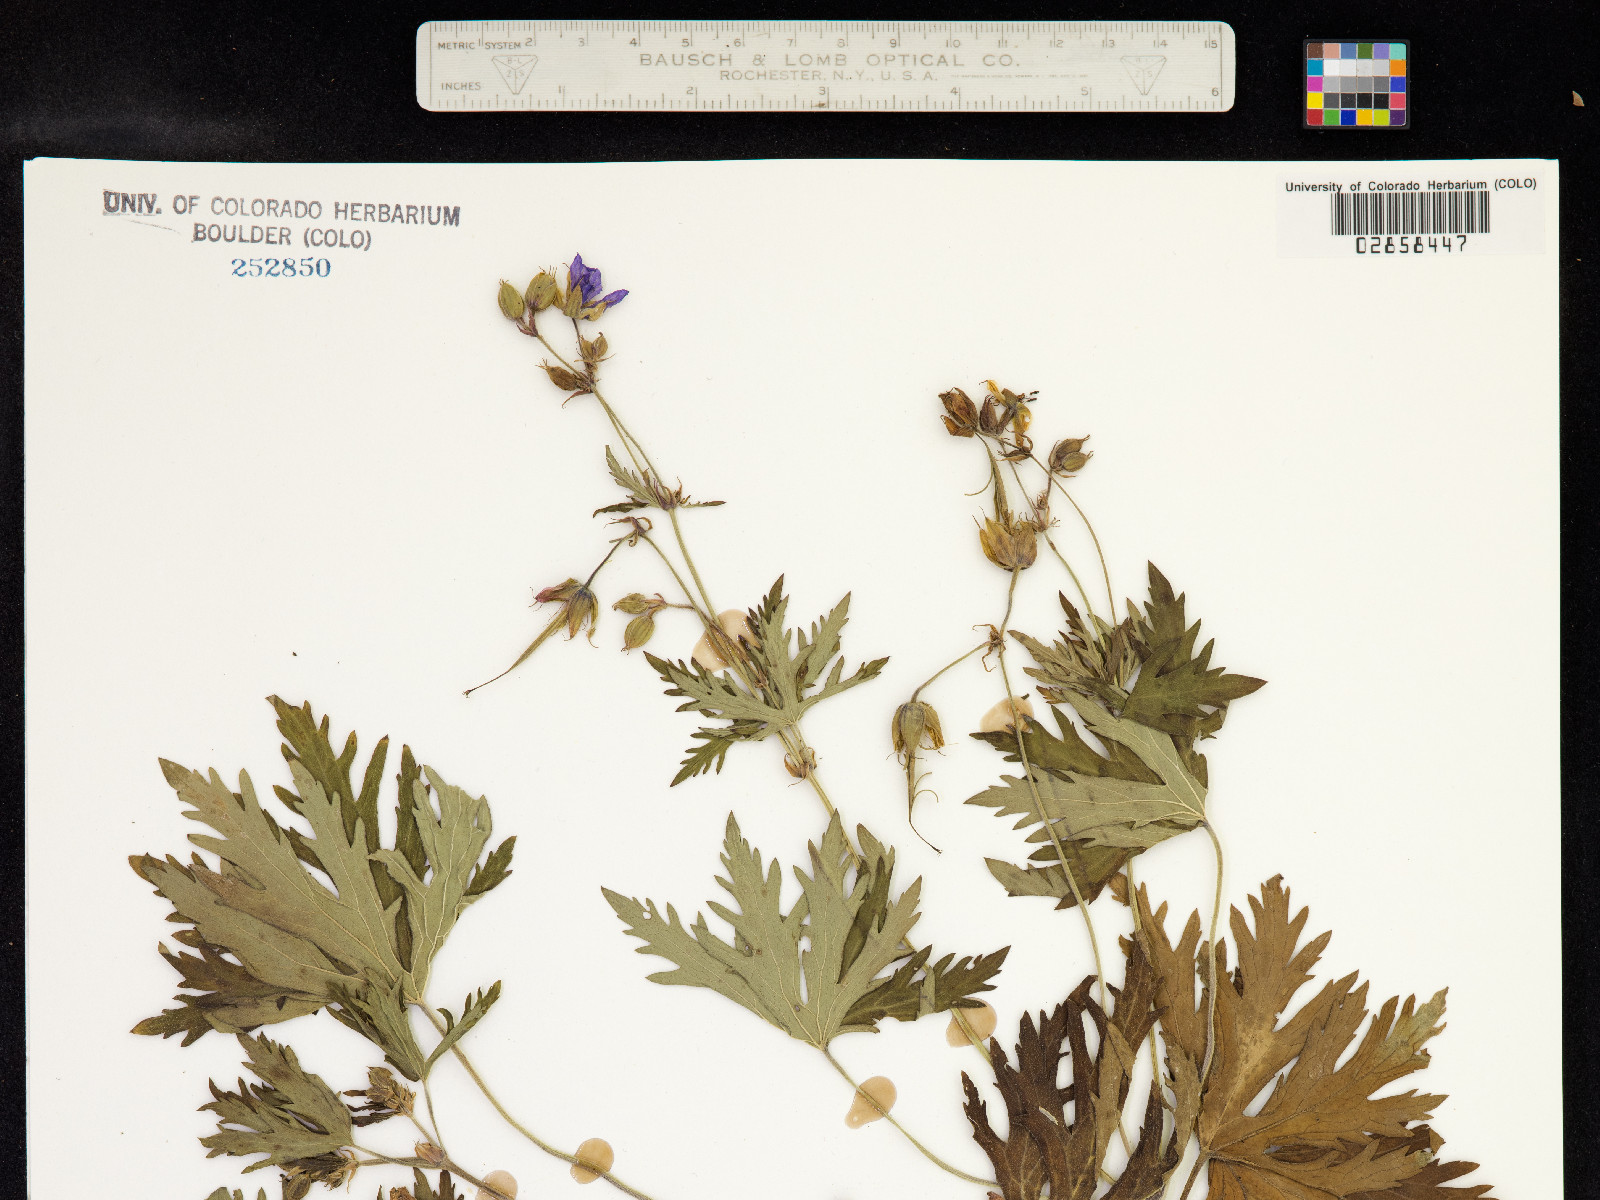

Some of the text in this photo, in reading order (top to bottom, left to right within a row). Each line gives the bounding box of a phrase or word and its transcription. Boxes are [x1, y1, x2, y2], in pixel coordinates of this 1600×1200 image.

[437, 42, 521, 50] METRIC SYSTEM
[525, 38, 533, 47] 2
[578, 38, 585, 47] 3
[629, 38, 638, 47] 4
[681, 38, 690, 47] 5
[733, 38, 742, 47] 6
[786, 38, 794, 47] 7
[837, 38, 846, 48] 8
[889, 38, 897, 48] 9
[946, 39, 961, 48] 10
[1050, 39, 1064, 48] 12
[1102, 39, 1116, 48] 13
[1154, 40, 1168, 48] 14
[1205, 40, 1218, 48] 15
[639, 53, 1020, 67] BAUSCH & LOMB OPTICAL CO.
[441, 82, 481, 90] INCHES
[686, 86, 694, 95] 2
[818, 86, 826, 96] 3
[950, 87, 959, 96] 4
[1081, 87, 1089, 96] 5
[1211, 87, 1219, 96] 6
[1285, 178, 1537, 195] University of Colorado Herbarium (COLO)
[103, 190, 461, 228] UNIV. OF COLORADO HERBARIUM
[192, 222, 372, 252] BOULDER (COLO)
[231, 256, 331, 278] 252850
